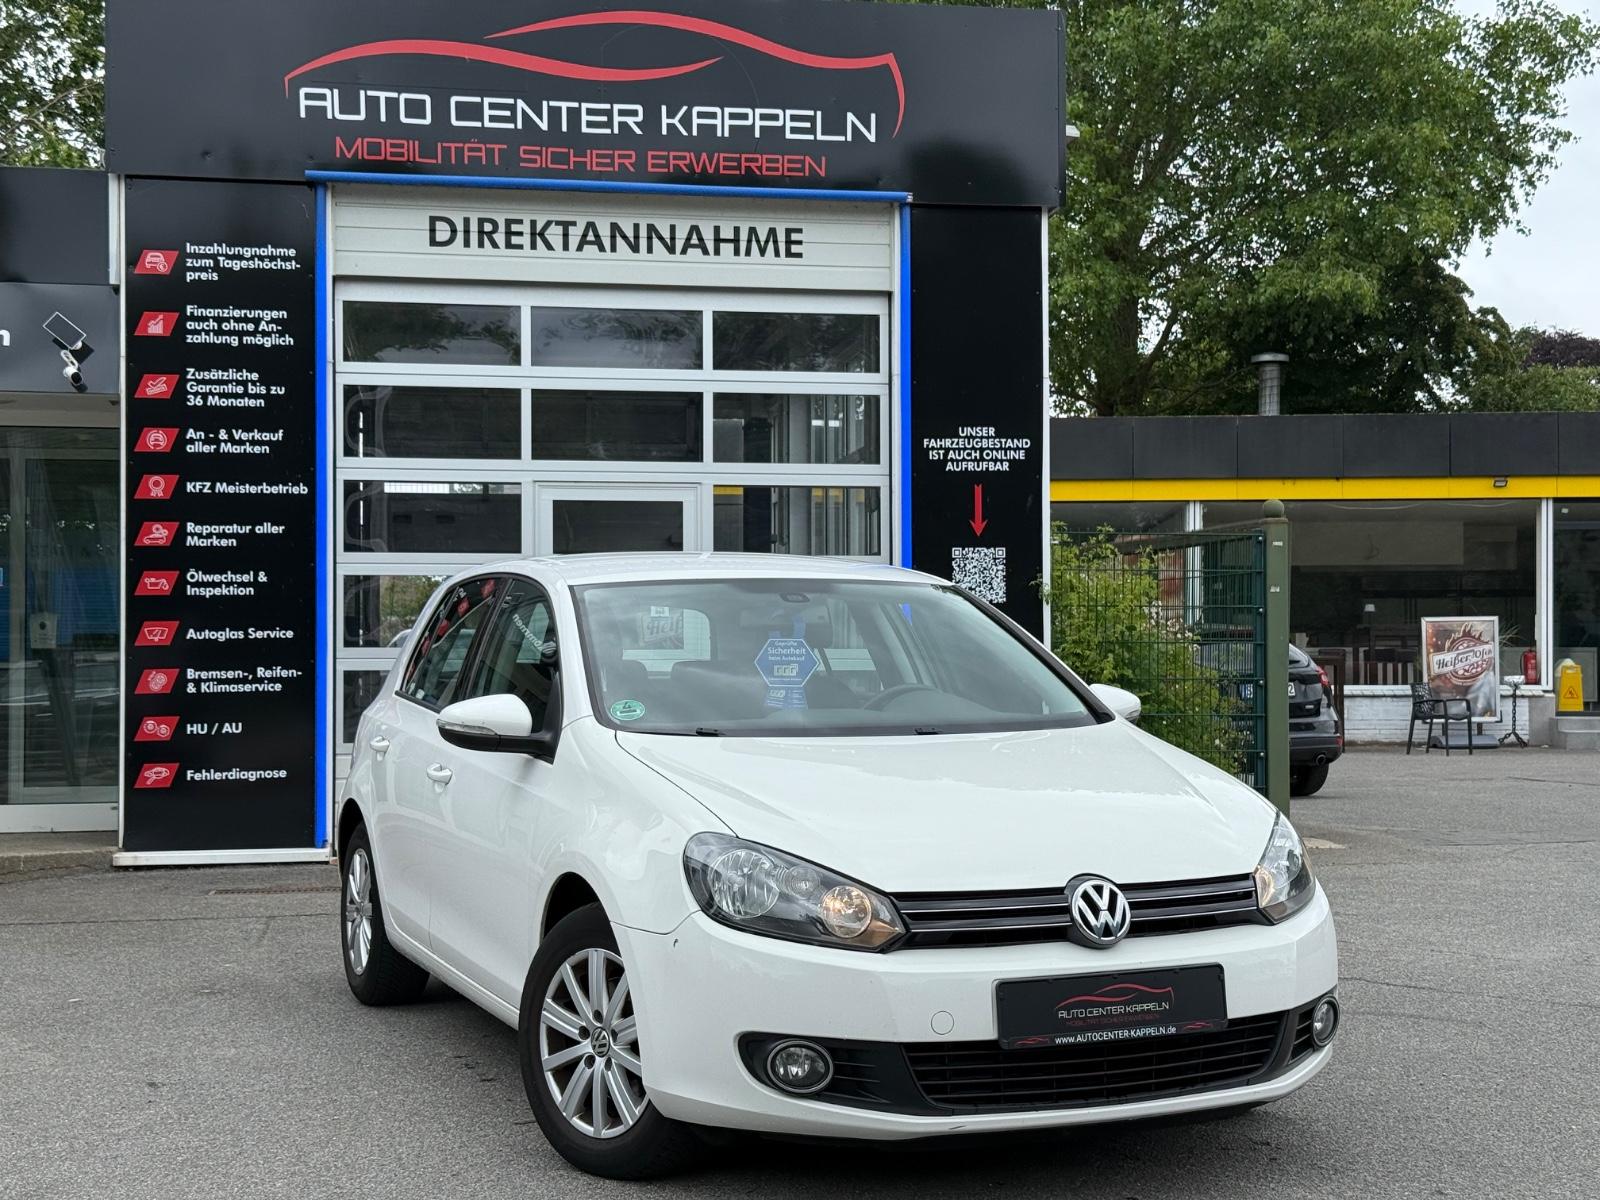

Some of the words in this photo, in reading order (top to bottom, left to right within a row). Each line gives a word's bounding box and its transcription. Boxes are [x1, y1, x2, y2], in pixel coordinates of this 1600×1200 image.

[299, 87, 432, 125] AUTO
[450, 95, 644, 135] CENTER
[661, 104, 876, 143] KAPPELN
[335, 136, 507, 166] MOBILITÄT
[519, 145, 636, 172] SICHER
[647, 150, 826, 177] ERWERBEN
[428, 215, 804, 259] DIREKTANNAHME
[186, 242, 297, 257] Inzahlungnahme
[186, 258, 214, 267] zum
[218, 256, 301, 271] Tageshöchst-
[186, 269, 219, 282] preis
[186, 305, 287, 320] Finanzierungen
[186, 319, 218, 330] auch
[221, 320, 255, 332] ohne
[258, 321, 282, 332] An-
[186, 333, 239, 347] zahlung
[243, 333, 294, 348] möglich
[186, 368, 259, 381] Zusätzliche
[186, 381, 244, 394] Garantie
[248, 382, 267, 394] bis
[270, 385, 285, 394] zu
[186, 395, 204, 406] 36
[207, 395, 265, 407] Monaten
[186, 428, 205, 439] An
[218, 429, 229, 440] &
[232, 429, 284, 441] Verkauf
[958, 426, 995, 437] UNSER
[186, 442, 216, 453] aller
[220, 442, 270, 454] Marken
[923, 438, 1031, 449] FAHRZEUGBESTAND
[929, 450, 945, 460] IST
[948, 450, 980, 460] AUCH
[983, 450, 1025, 460] ONLINE
[946, 461, 1010, 472] AUFRUFBAR
[186, 482, 212, 493] KFZ
[215, 482, 308, 495] Meisterbetrieb
[186, 522, 252, 536] Reparatur
[255, 522, 285, 534] aller
[186, 536, 237, 547] Marken
[186, 568, 254, 583] Ölwechsel
[257, 572, 268, 583] &
[186, 584, 254, 598] Inspektion
[186, 628, 244, 641] Autoglas
[248, 627, 294, 639] Service
[767, 646, 807, 655] Sicherheit
[186, 668, 253, 680] Bremsen-,
[257, 666, 302, 678] Reifen-
[186, 682, 197, 694] &
[200, 680, 282, 693] Klimaservice
[186, 723, 208, 735] HU
[211, 722, 219, 735] /
[222, 722, 243, 734] AU
[186, 767, 287, 782] Fehlerdiagnose
[1058, 1008, 1086, 1019] AUTO
[1086, 1005, 1125, 1017] CENTER
[1125, 1001, 1170, 1013] KAPPELN
[1055, 1025, 1177, 1045] www.AUTOCENTER-KAPPELN.de
